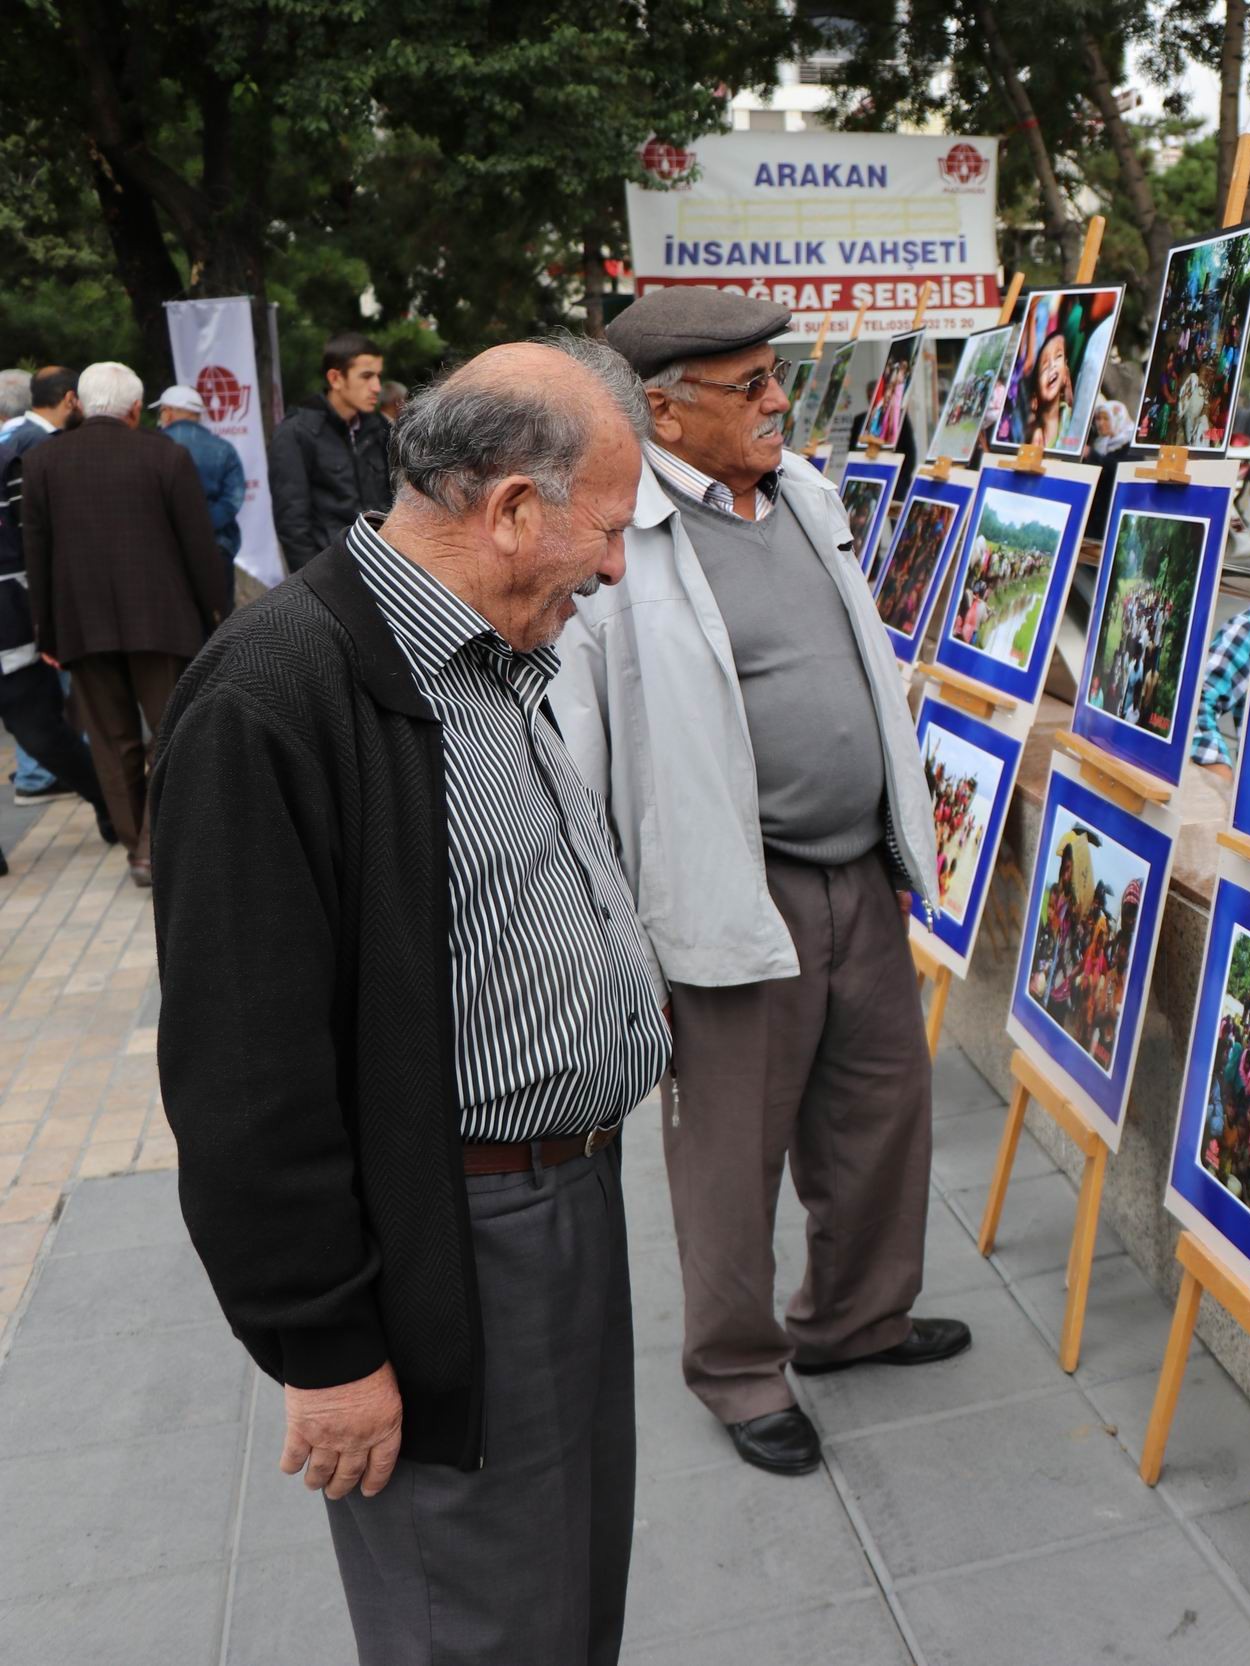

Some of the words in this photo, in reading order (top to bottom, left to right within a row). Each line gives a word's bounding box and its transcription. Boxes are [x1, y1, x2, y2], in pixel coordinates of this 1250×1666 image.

[754, 163, 888, 188] ARAKAN
[664, 235, 826, 266] İNSANLIK
[838, 235, 968, 271] VAHŞETİ
[851, 276, 986, 309] SERGİSİ
